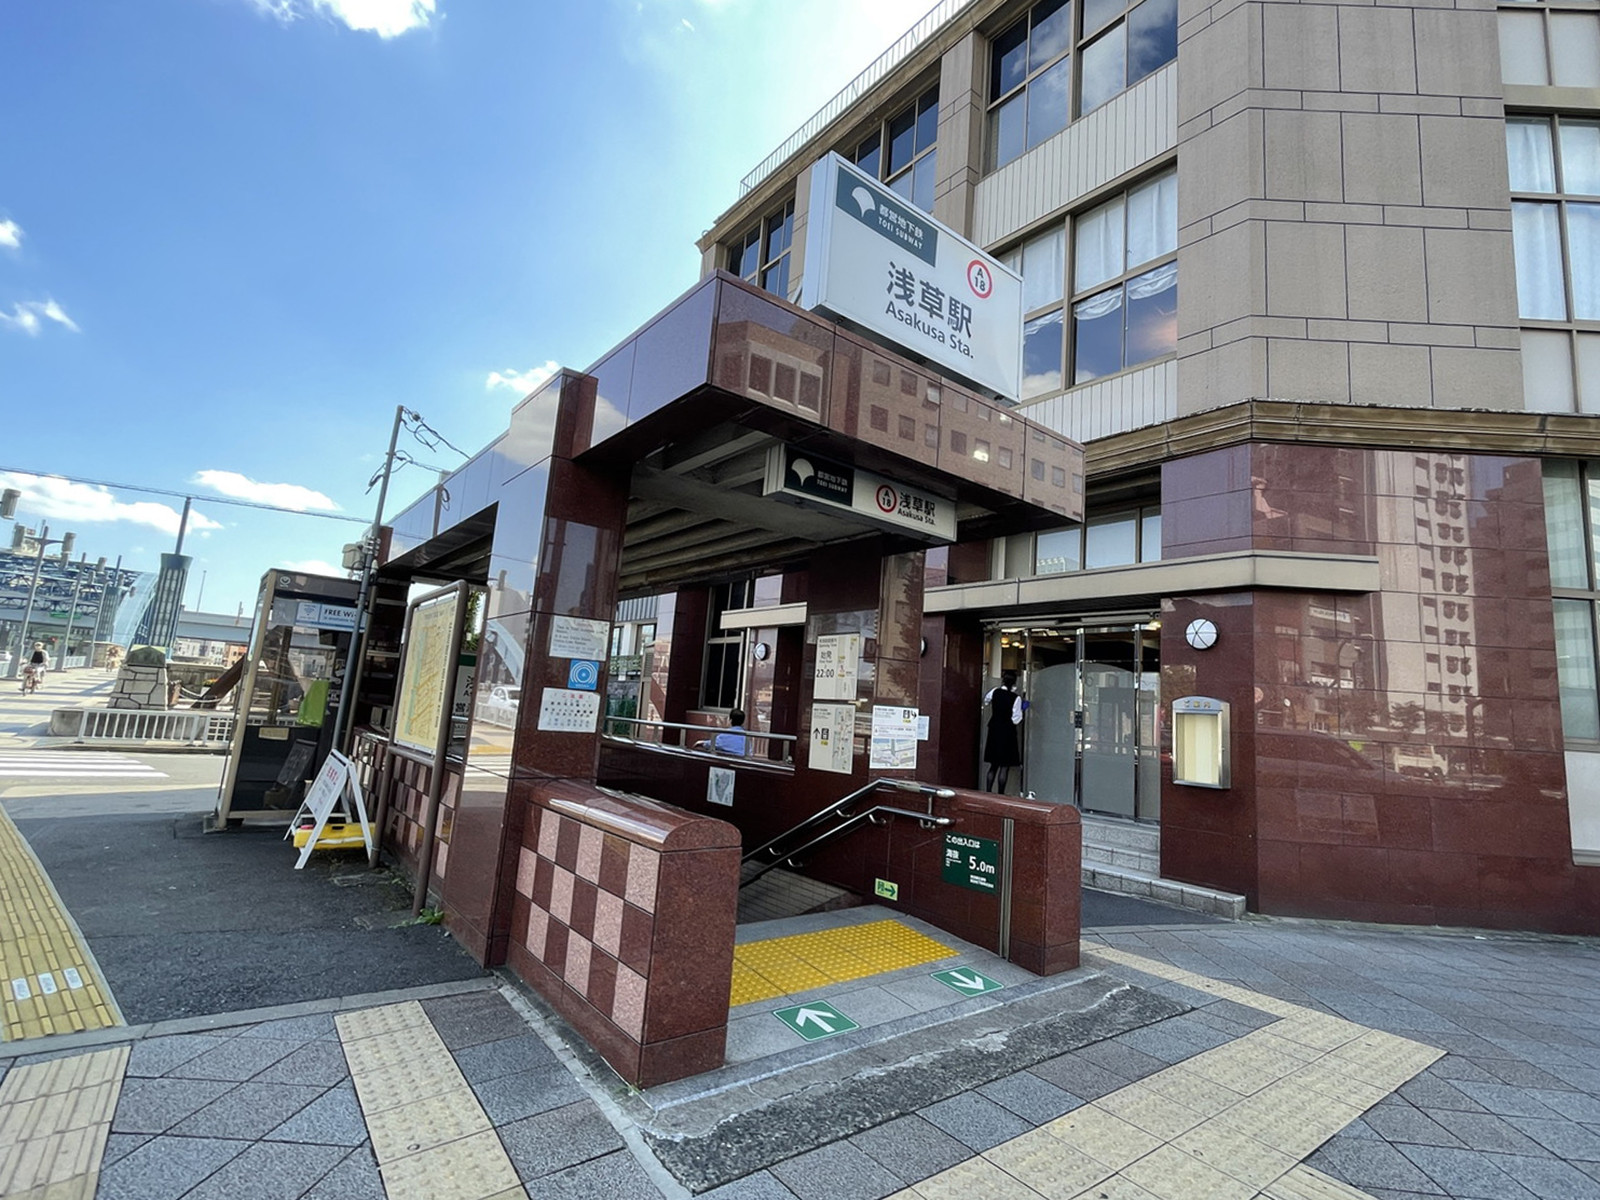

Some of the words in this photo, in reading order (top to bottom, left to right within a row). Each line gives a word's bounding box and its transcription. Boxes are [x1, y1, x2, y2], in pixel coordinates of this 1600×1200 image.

[879, 204, 924, 240] 都営地下鉄
[878, 217, 894, 232] TOEI
[895, 228, 923, 249] SUBWAY
[976, 268, 984, 278] A
[974, 277, 986, 292] 18
[886, 261, 973, 338] 浅草駅
[885, 300, 946, 344] Asakusa
[949, 334, 974, 359] Sta.
[882, 497, 891, 507] 18
[884, 489, 890, 497] A
[899, 492, 936, 517] 浅草駅
[897, 508, 924, 522] Asakusa
[925, 516, 936, 526] Sta.
[324, 609, 341, 617] FREE
[816, 669, 835, 678] 22:00
[969, 856, 995, 874] 5.0m
